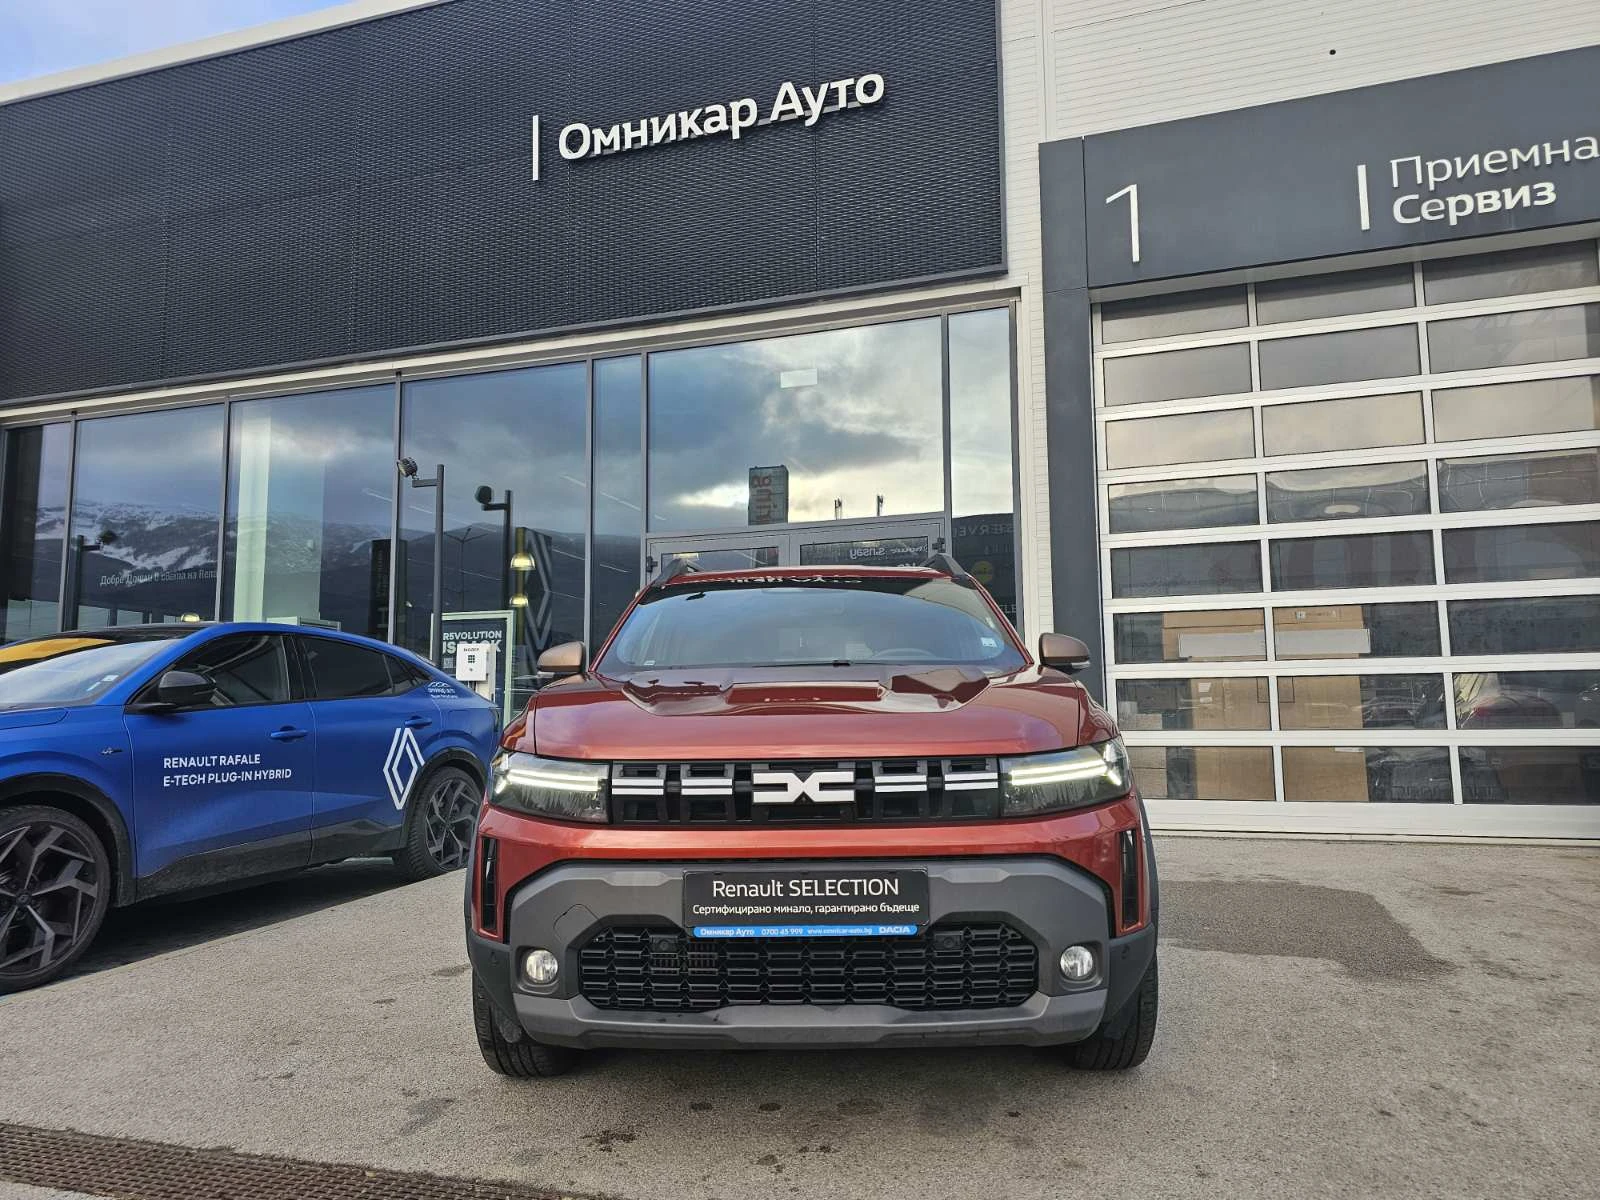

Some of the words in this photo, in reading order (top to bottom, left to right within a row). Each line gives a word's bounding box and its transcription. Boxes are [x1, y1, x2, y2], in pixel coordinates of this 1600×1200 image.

[558, 97, 758, 161] Омникар
[770, 72, 886, 127] Ауто
[1390, 134, 1600, 190] Приемна
[1392, 180, 1558, 226] Сервиз
[1105, 183, 1140, 263] 1
[442, 630, 503, 641] R5VOLUTION
[442, 641, 456, 655] IS
[163, 755, 218, 769] RENAULT
[219, 753, 261, 766] RAFALE
[163, 774, 206, 787] E-TECH
[207, 771, 253, 784] PLUG-IN
[254, 768, 292, 781] HYBRID
[712, 879, 784, 898] Renault
[788, 878, 900, 897] SELECTION
[692, 904, 772, 916] Сертифицирано
[773, 904, 813, 915] минало,
[814, 903, 878, 915] гарантирано
[879, 902, 920, 914] бъдеще
[735, 927, 755, 937] Ауто
[761, 928, 779, 936] 0700
[879, 926, 911, 935] DACIA
